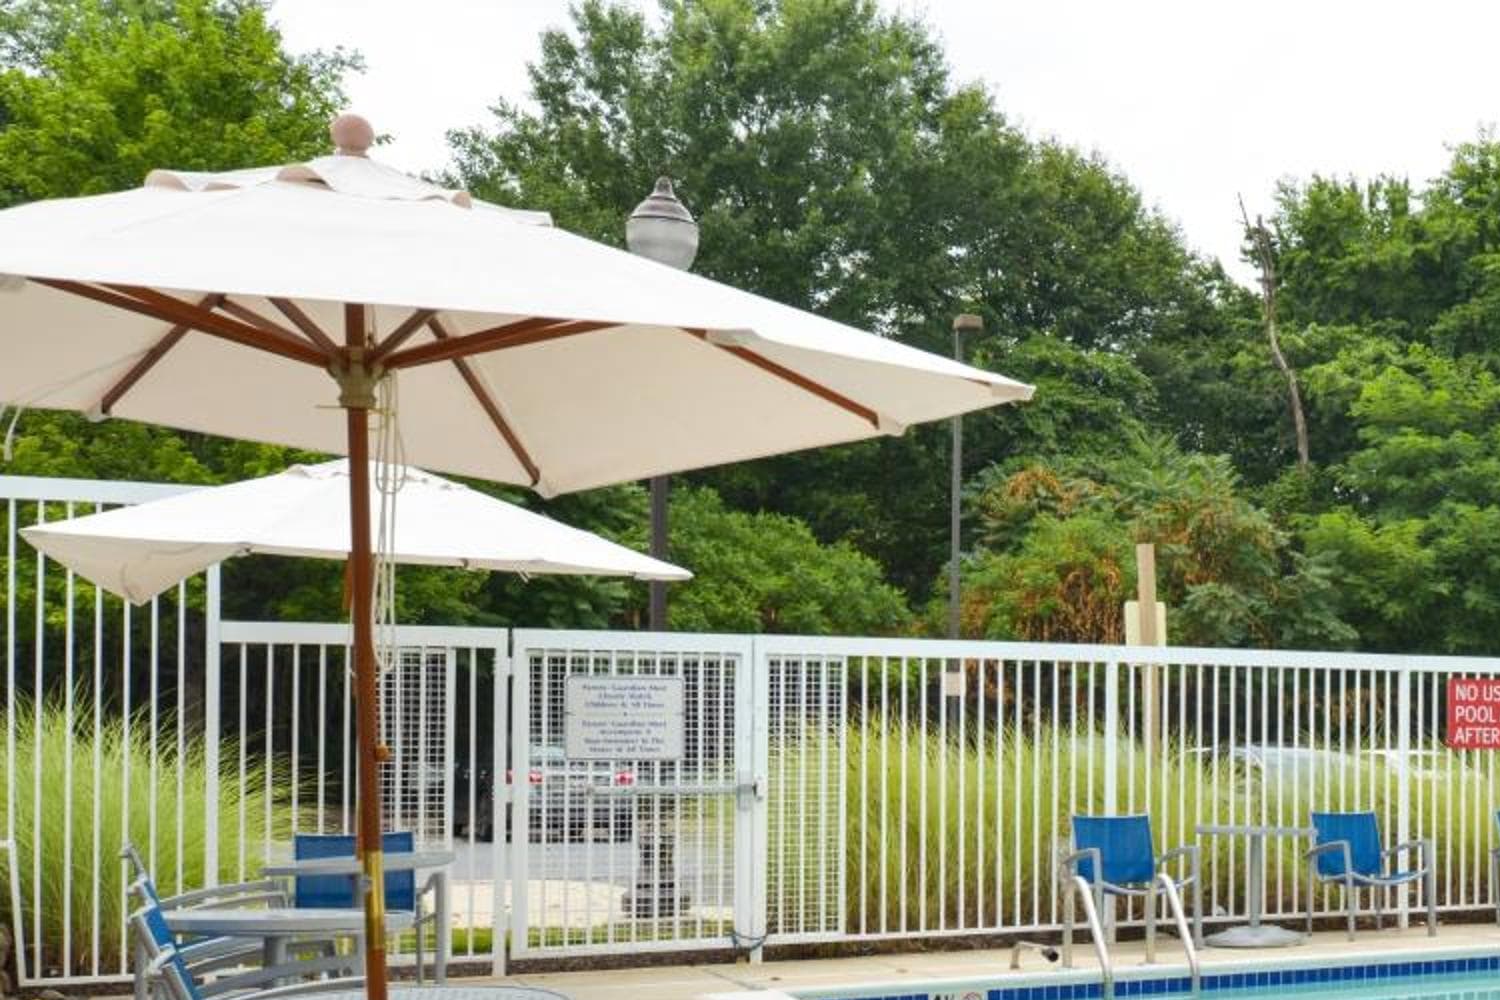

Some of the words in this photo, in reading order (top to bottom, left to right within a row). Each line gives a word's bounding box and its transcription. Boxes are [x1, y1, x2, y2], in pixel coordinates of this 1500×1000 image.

[1455, 684, 1479, 701] NO
[1455, 705, 1497, 723] POOL
[1454, 727, 1500, 744] AFTER
